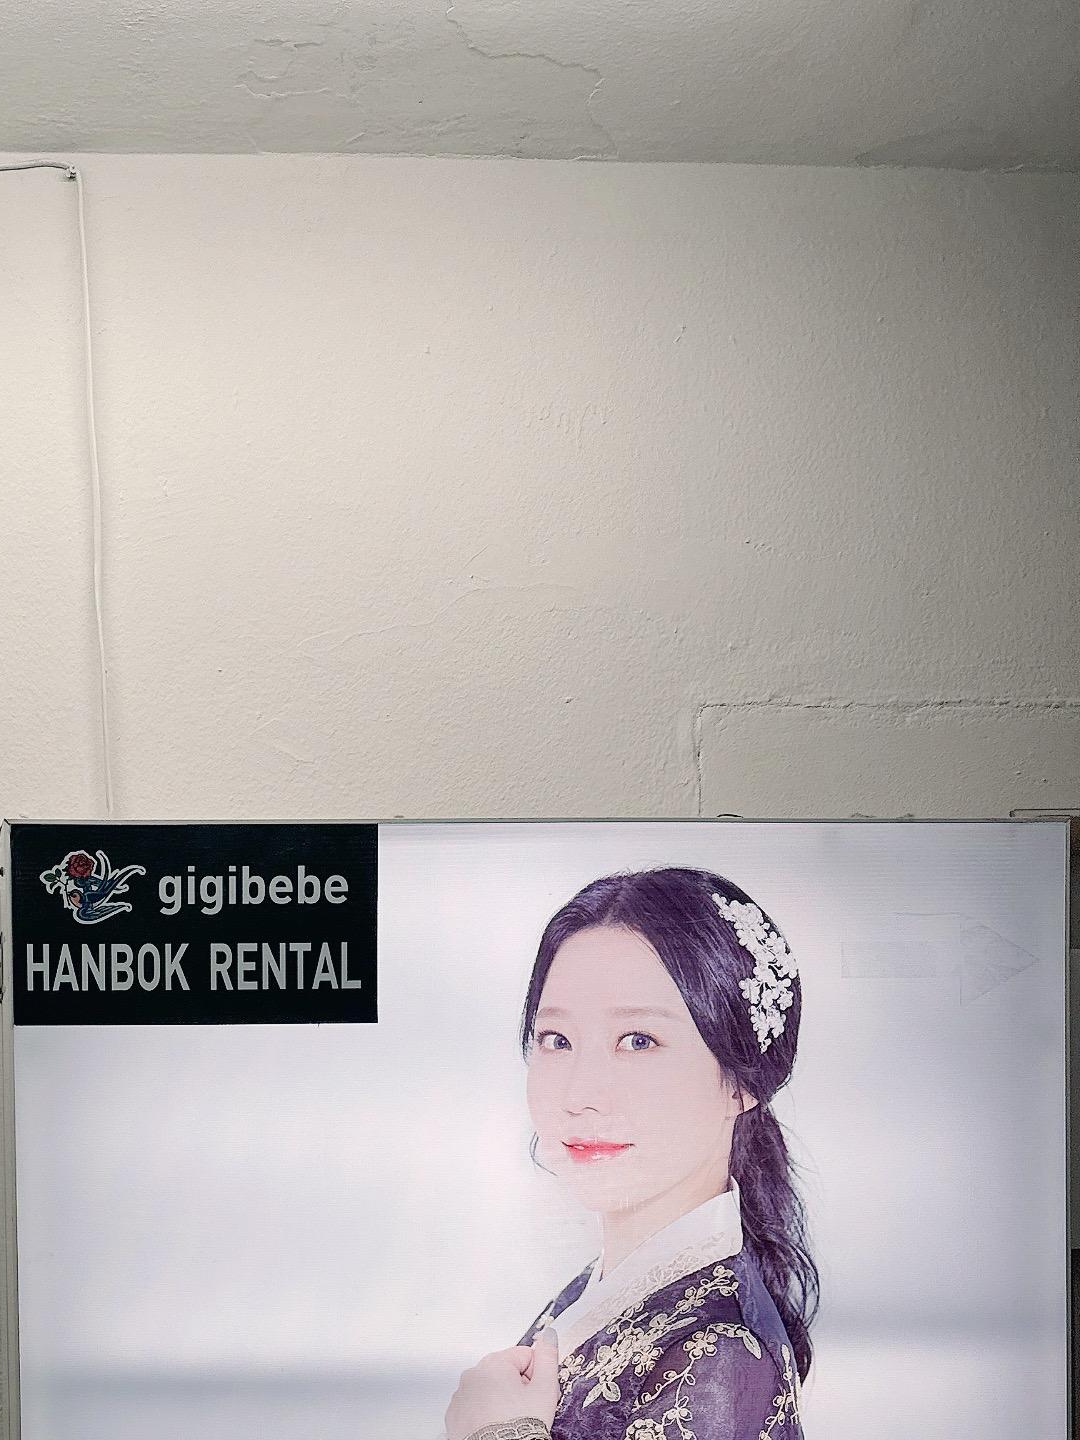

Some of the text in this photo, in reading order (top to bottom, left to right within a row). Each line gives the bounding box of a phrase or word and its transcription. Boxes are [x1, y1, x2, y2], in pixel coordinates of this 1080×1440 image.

[159, 865, 348, 915] gigibebe
[26, 942, 362, 991] HANBOK RENTAL
